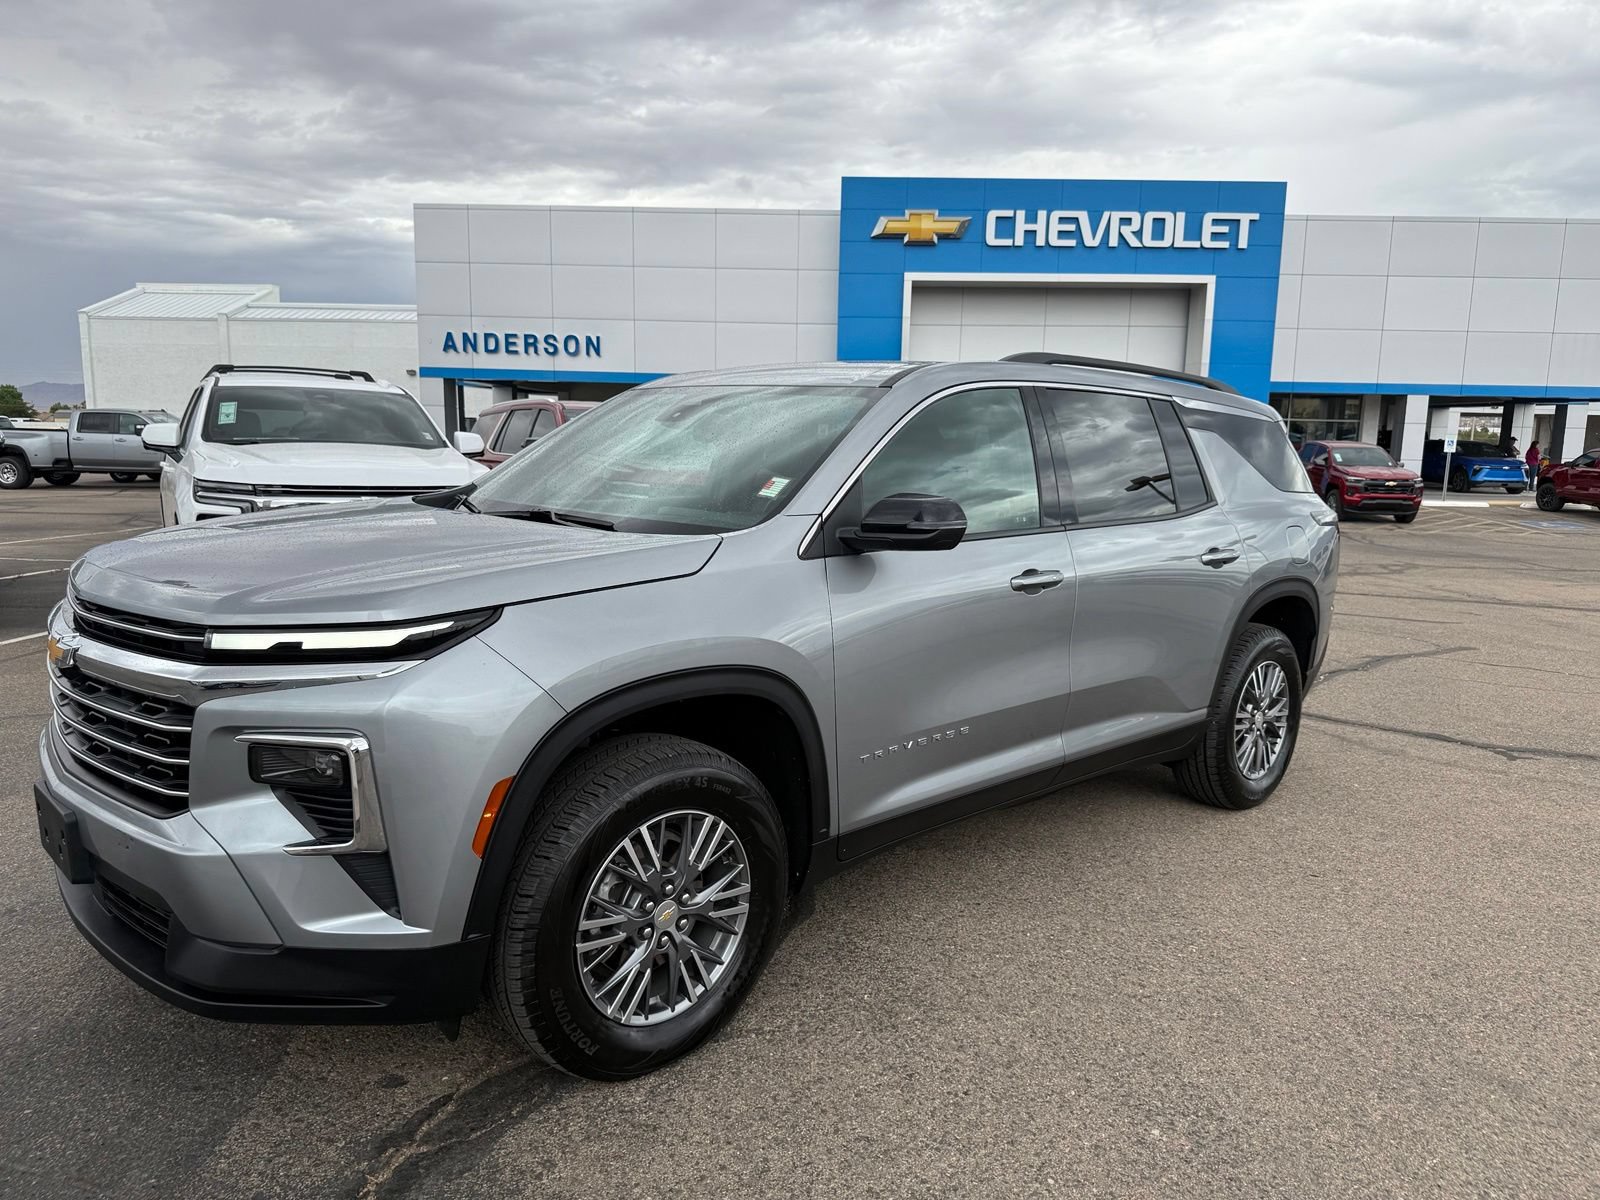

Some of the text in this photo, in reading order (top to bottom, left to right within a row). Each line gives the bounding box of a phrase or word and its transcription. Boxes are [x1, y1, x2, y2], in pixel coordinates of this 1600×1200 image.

[985, 209, 1260, 249] CHEVROLET
[443, 331, 602, 357] ANDERSON
[859, 726, 970, 763] TRAVERSE
[550, 987, 601, 1056] FORTUNE
